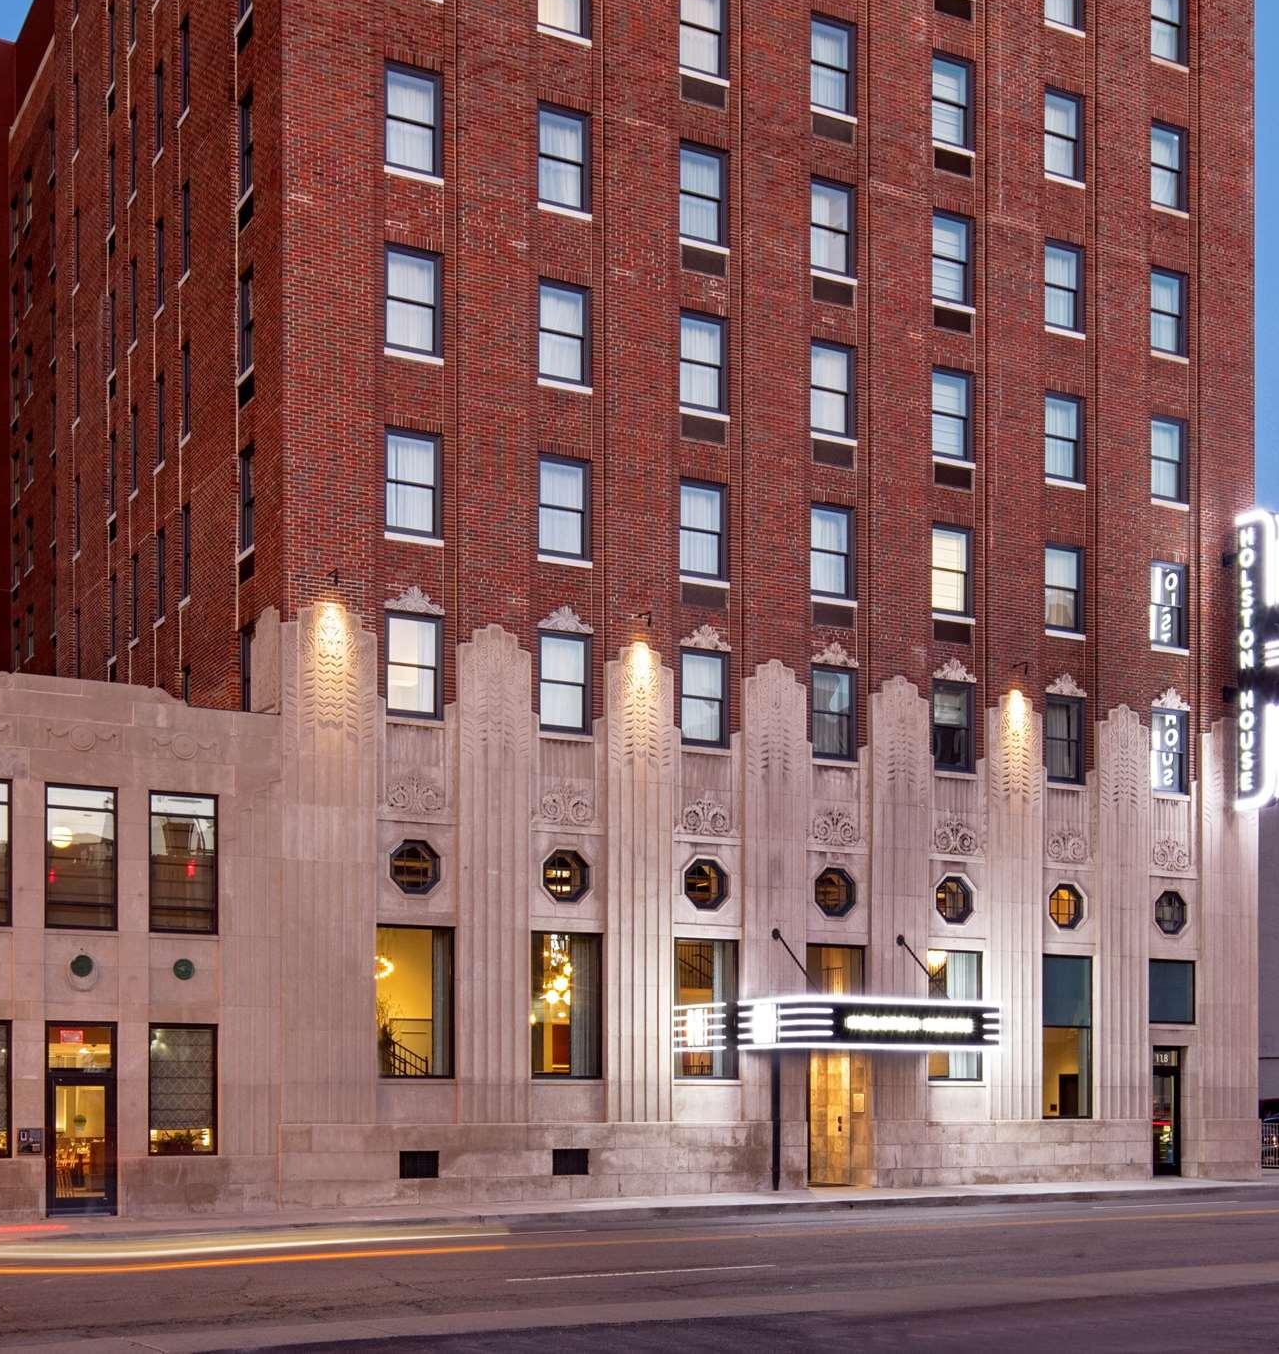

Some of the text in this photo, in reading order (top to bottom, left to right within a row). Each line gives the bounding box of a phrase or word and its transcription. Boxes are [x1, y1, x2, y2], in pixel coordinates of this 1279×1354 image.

[1239, 526, 1256, 792] HOLSTON HOUSE
[1156, 1053, 1169, 1063] 118
